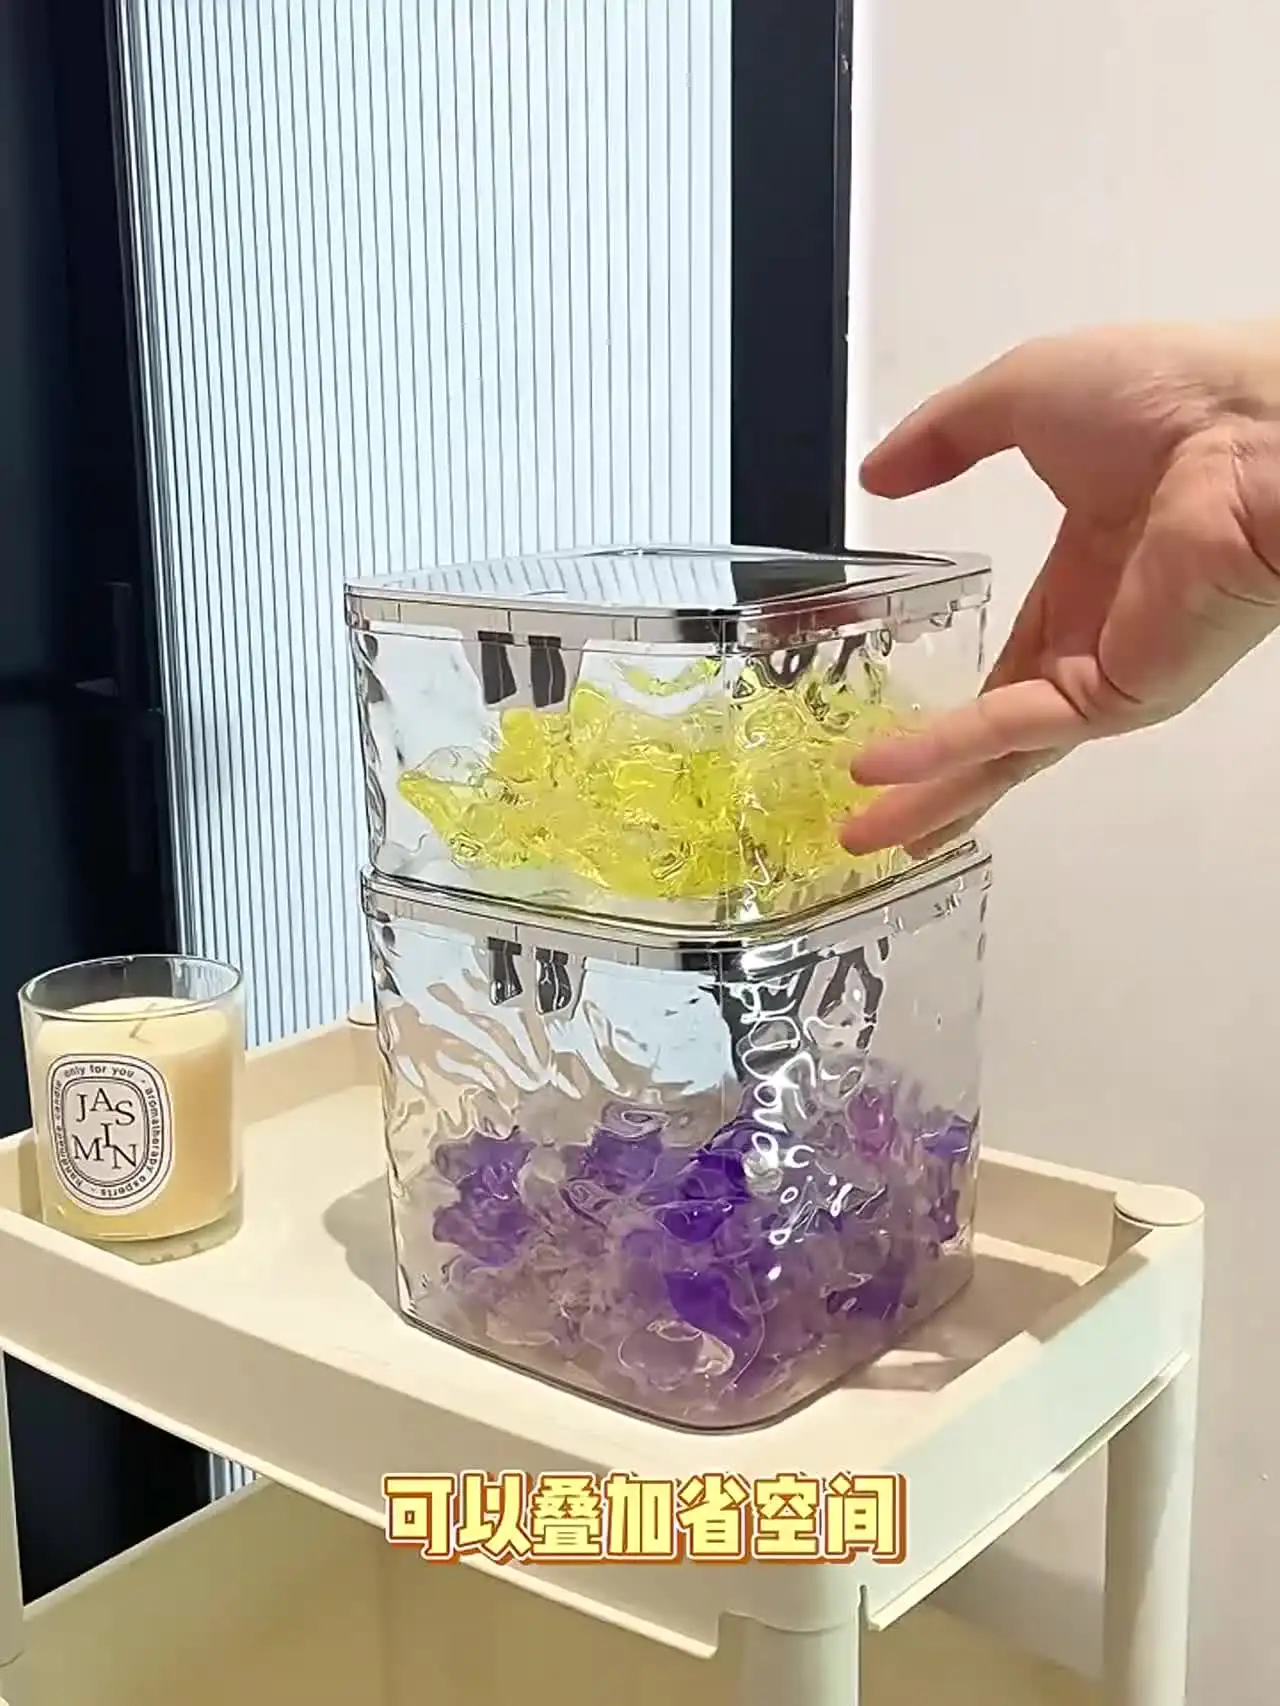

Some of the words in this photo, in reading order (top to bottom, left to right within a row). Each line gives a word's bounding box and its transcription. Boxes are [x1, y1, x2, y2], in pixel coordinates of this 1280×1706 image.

[63, 1064, 86, 1078] only
[90, 1064, 107, 1075] for
[112, 1066, 135, 1078] you
[145, 1088, 161, 1175] aromatherapy
